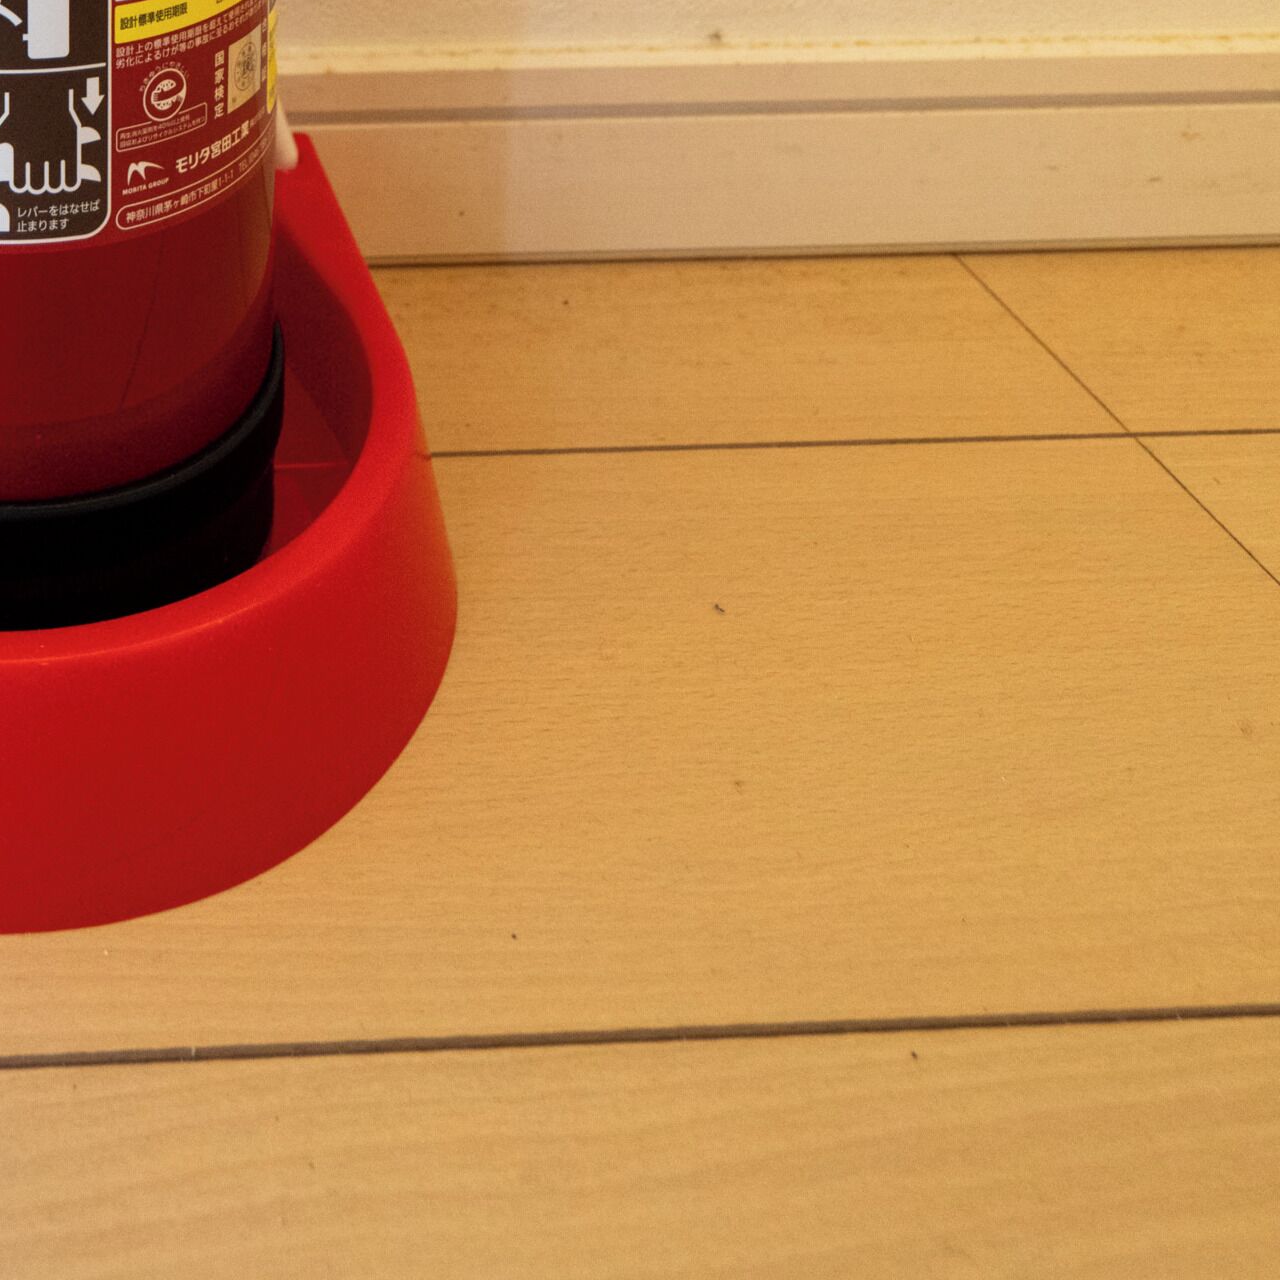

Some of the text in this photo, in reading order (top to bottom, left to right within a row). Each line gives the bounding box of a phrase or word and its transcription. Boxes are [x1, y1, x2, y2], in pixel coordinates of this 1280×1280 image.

[120, 2, 188, 30] 設計標準使用期限
[175, 120, 249, 174] モリタ宮田工業
[122, 177, 169, 196] MORITA GROUP
[18, 198, 100, 218] レバーをはなせば
[17, 218, 69, 233] 止まります
